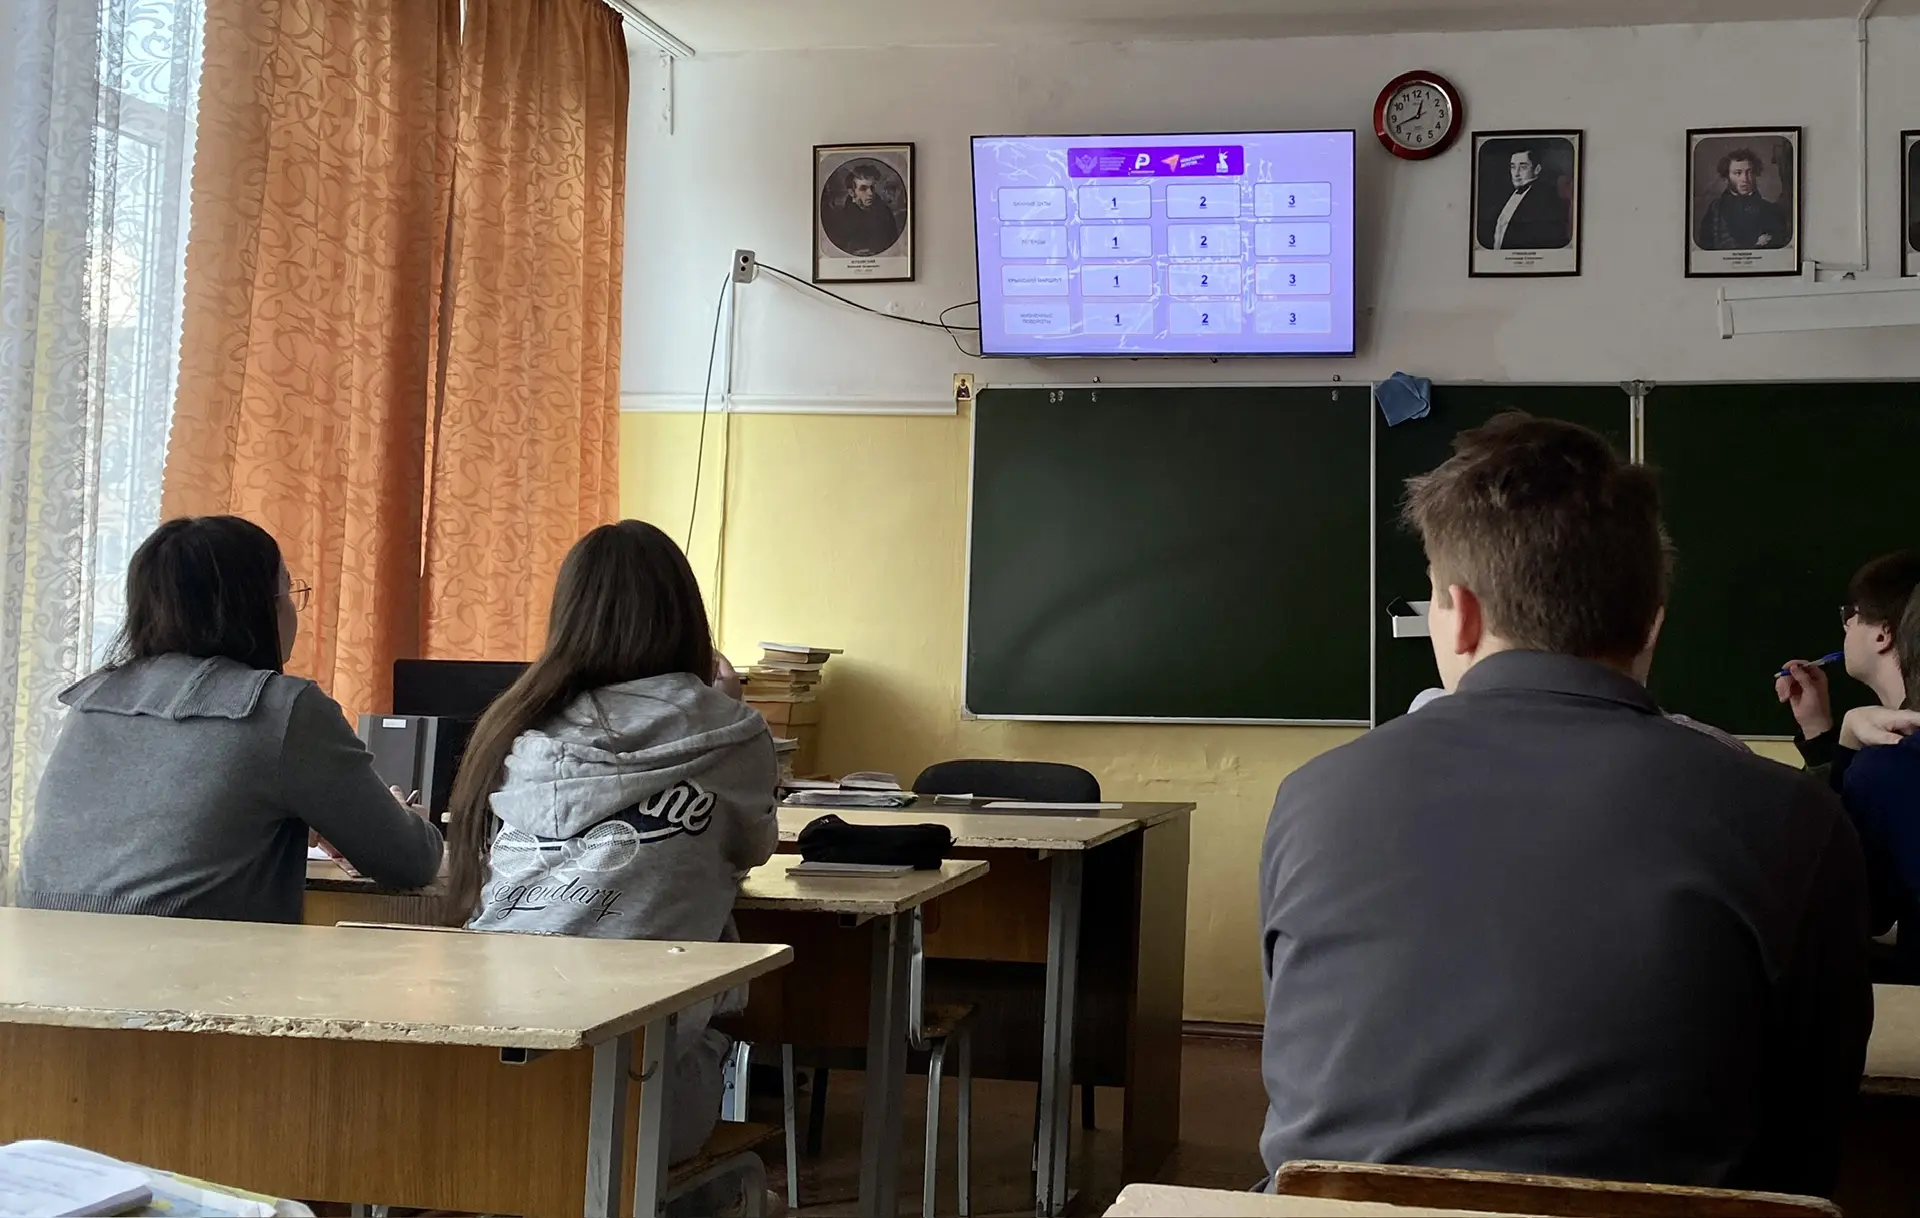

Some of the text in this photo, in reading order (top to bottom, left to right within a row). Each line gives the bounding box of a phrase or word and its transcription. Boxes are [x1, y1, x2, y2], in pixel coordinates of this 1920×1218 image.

[1402, 94, 1410, 102] 11
[1412, 89, 1422, 98] 12
[1426, 91, 1430, 100] 1
[1394, 102, 1404, 111] 10
[1434, 98, 1440, 107] 2
[1391, 114, 1397, 123] 9
[1438, 109, 1444, 118] 3
[1395, 125, 1402, 134] 8
[1435, 121, 1441, 130] 4
[1406, 132, 1412, 141] 7
[1416, 134, 1422, 143] 6
[1427, 130, 1434, 139] 5
[1111, 196, 1118, 208] 1
[1199, 195, 1207, 207] 2
[1288, 194, 1296, 206] 3
[1112, 236, 1119, 247] 1
[1200, 235, 1208, 246] 2
[1288, 233, 1296, 245] 3
[1113, 275, 1120, 286] 1
[1201, 274, 1209, 285] 2
[1288, 273, 1296, 284] 3
[1114, 313, 1121, 324] 1
[1202, 312, 1209, 324] 2
[1289, 312, 1297, 323] 3
